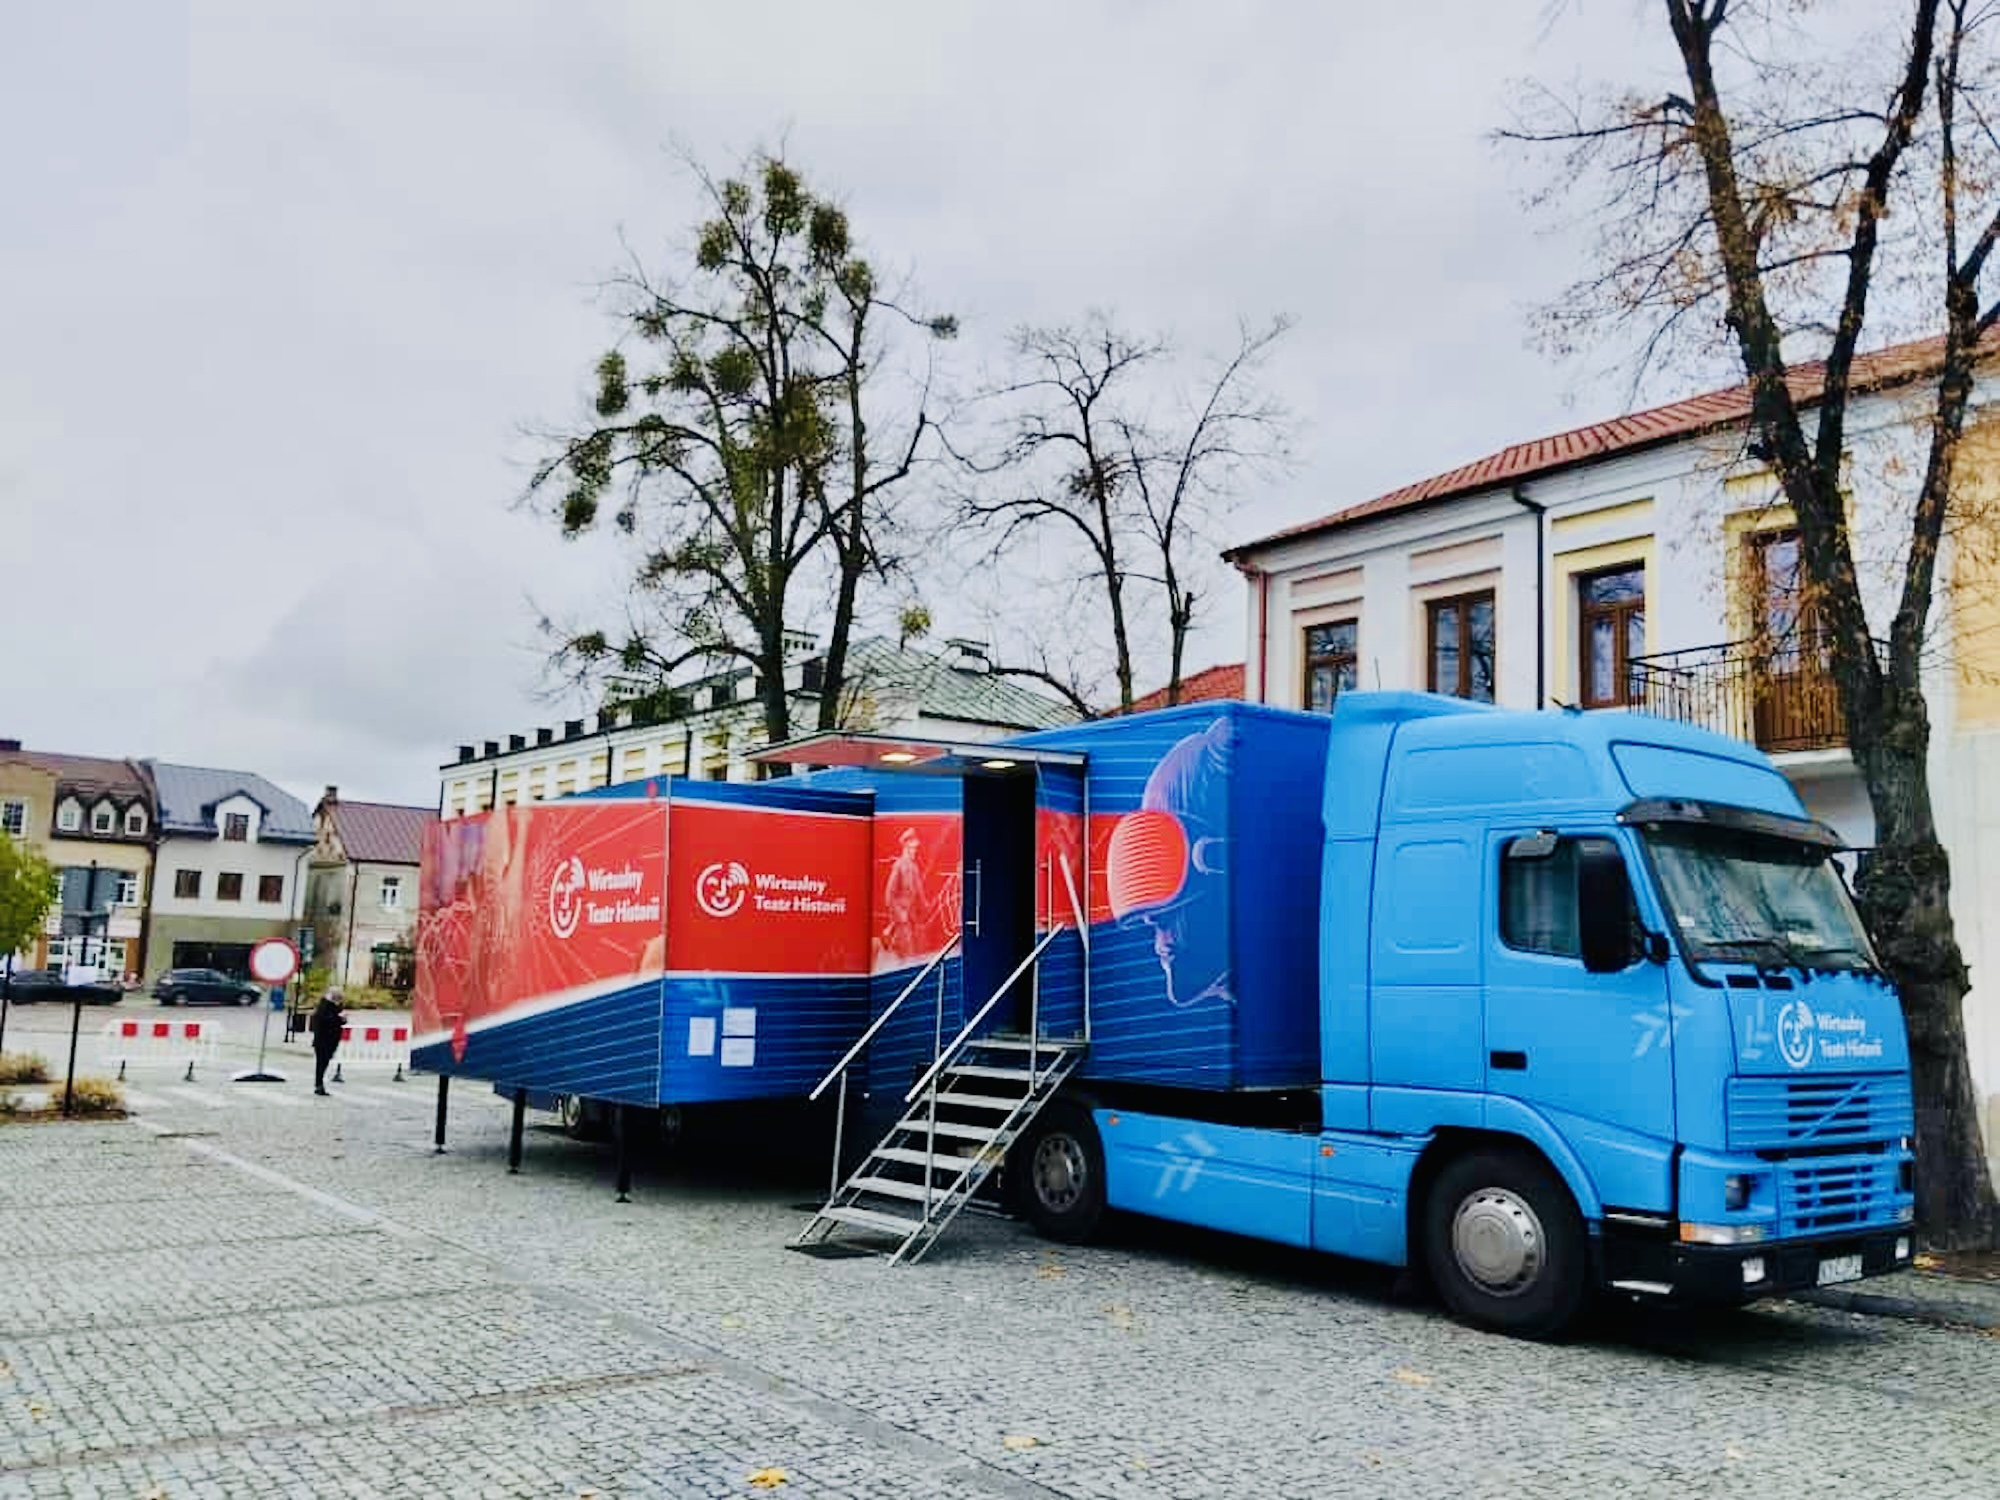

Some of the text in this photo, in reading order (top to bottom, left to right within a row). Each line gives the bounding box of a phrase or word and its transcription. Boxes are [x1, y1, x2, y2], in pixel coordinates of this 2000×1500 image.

[588, 867, 643, 892] Wirtualny
[755, 874, 826, 893] Wirtualny
[587, 898, 659, 923] Teatr Historii
[755, 895, 846, 913] Teatr Historii
